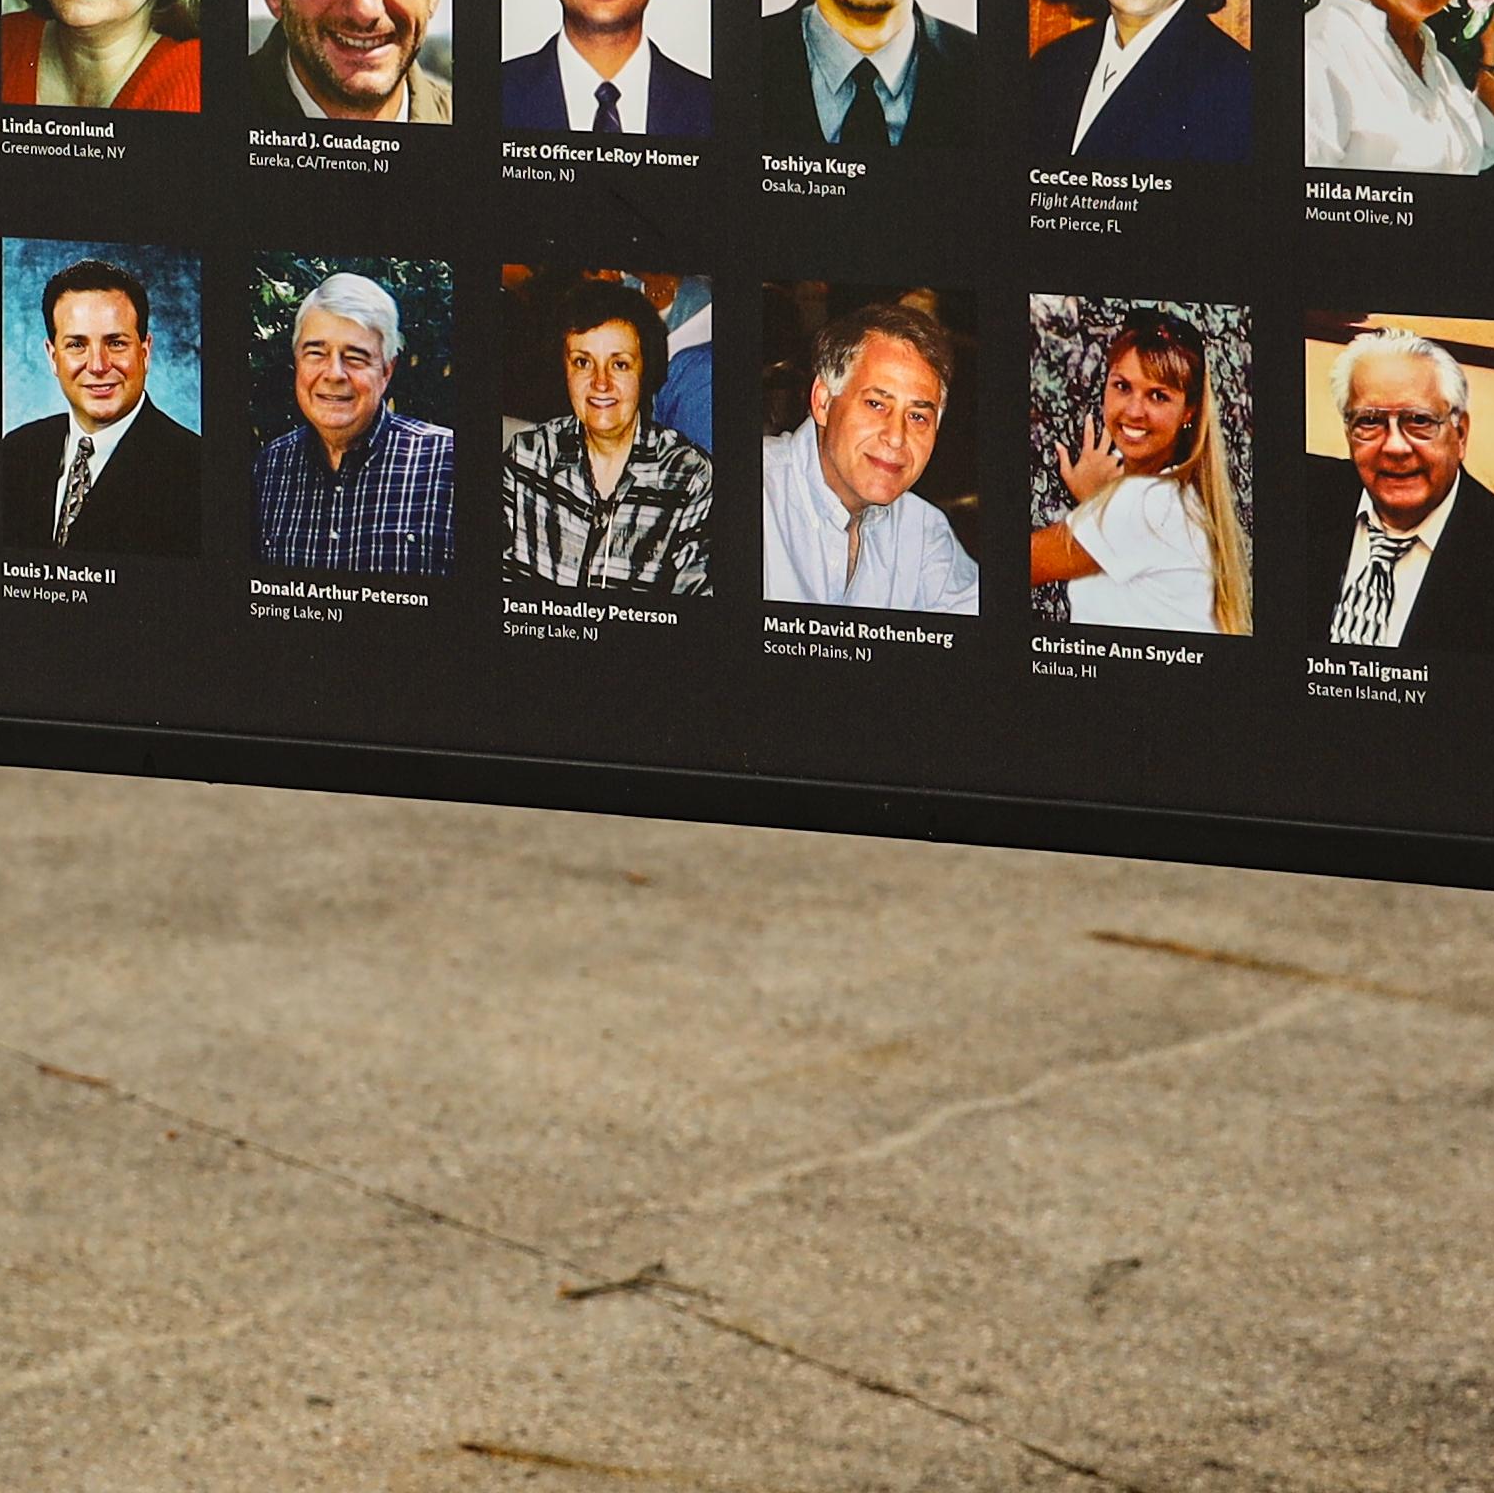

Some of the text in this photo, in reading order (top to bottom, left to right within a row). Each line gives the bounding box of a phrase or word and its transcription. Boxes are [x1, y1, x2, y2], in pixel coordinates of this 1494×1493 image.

[249, 130, 399, 154] Richard J. Guadagno
[250, 153, 388, 173] Eureka, CA/Trenton, NJ
[503, 142, 699, 167] First Officer LeRoy Homer
[503, 166, 574, 182] Marlton, NJ
[762, 155, 865, 178] Toshiya Kuge
[762, 179, 845, 197] Osaka, Japan
[1306, 183, 1413, 203] Hilda Marcin
[1306, 207, 1413, 226] Mount Olive, NJ
[4, 562, 115, 584] Louis J. Nacke II
[4, 585, 87, 603] New Hope, PA
[503, 598, 677, 624] Jean Hoadley Peterson
[504, 621, 597, 641] Spring Lake, NJ
[1032, 636, 1203, 665] Christine Ann Snyder
[1033, 661, 1096, 678] Kailua, HI
[1307, 658, 1428, 682] John Talignani
[1308, 682, 1426, 703] Staten Island, NY
